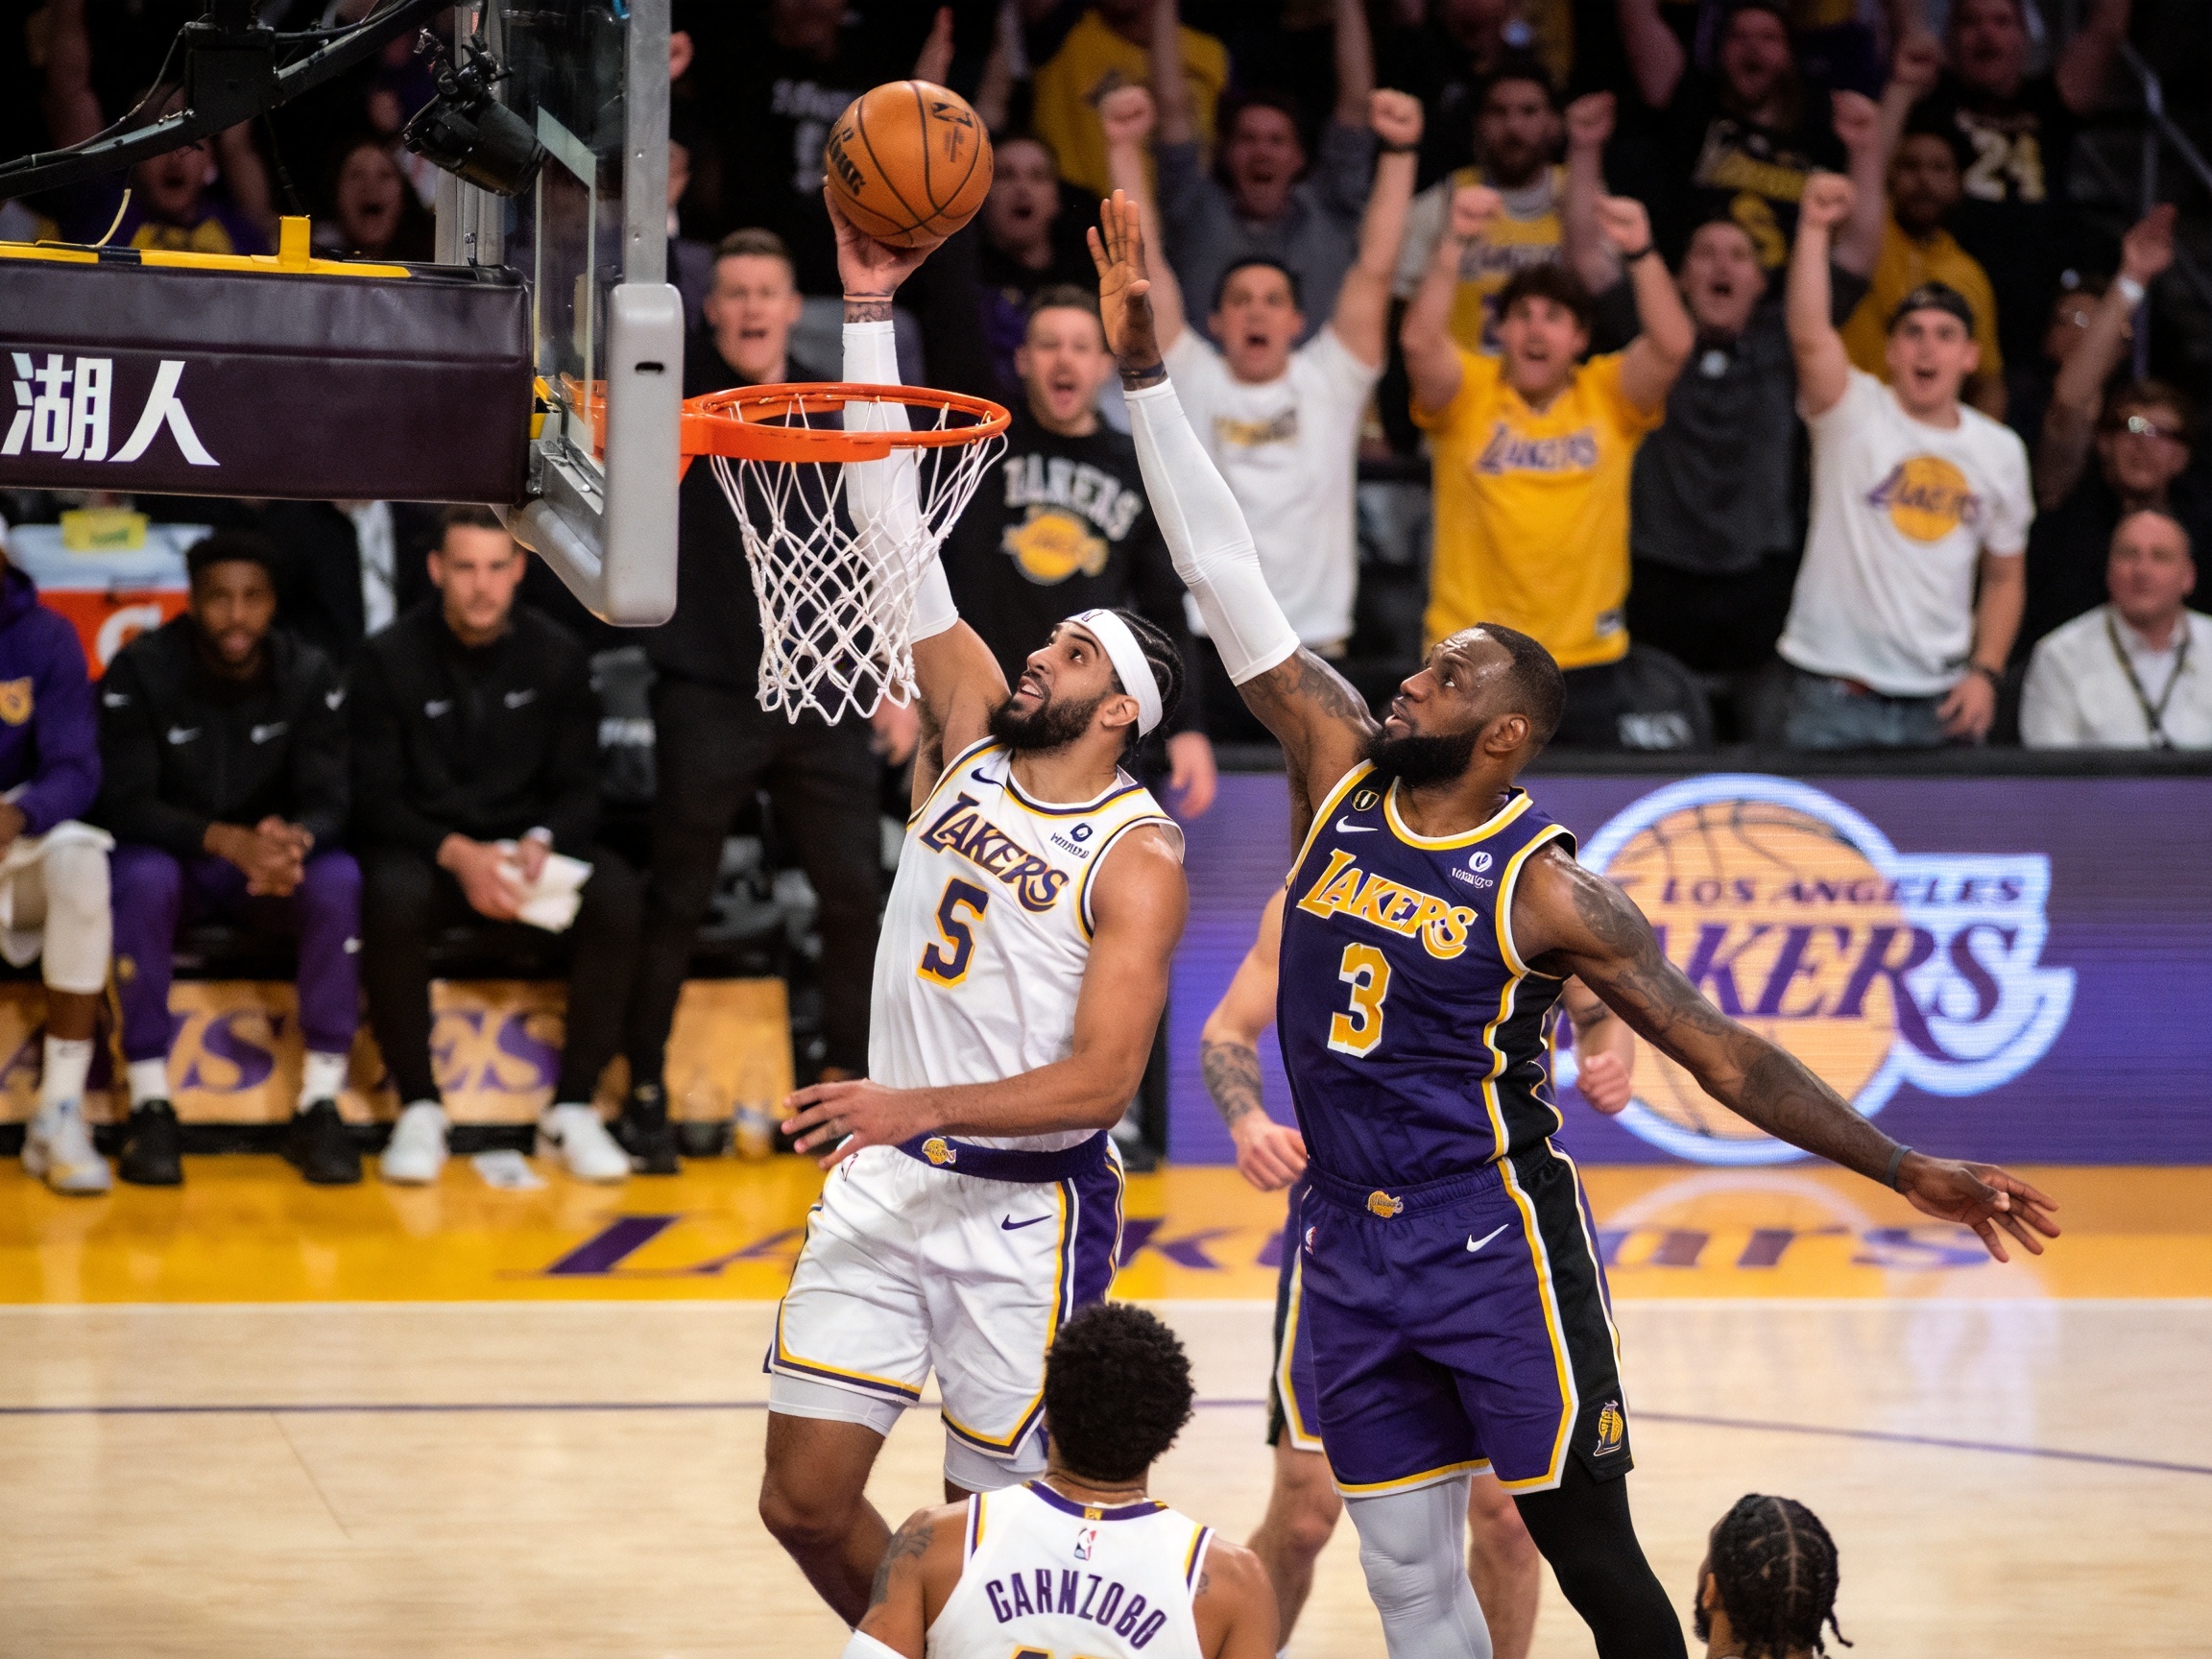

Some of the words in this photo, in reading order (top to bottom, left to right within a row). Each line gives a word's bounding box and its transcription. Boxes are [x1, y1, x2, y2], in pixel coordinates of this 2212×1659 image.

[0, 352, 221, 466] 湖人
[919, 791, 1070, 913] LAKERS
[1296, 848, 1479, 960] LAKERS
[1661, 878, 1757, 904] LOS
[917, 876, 990, 990] 5
[1327, 942, 1391, 1059] 3
